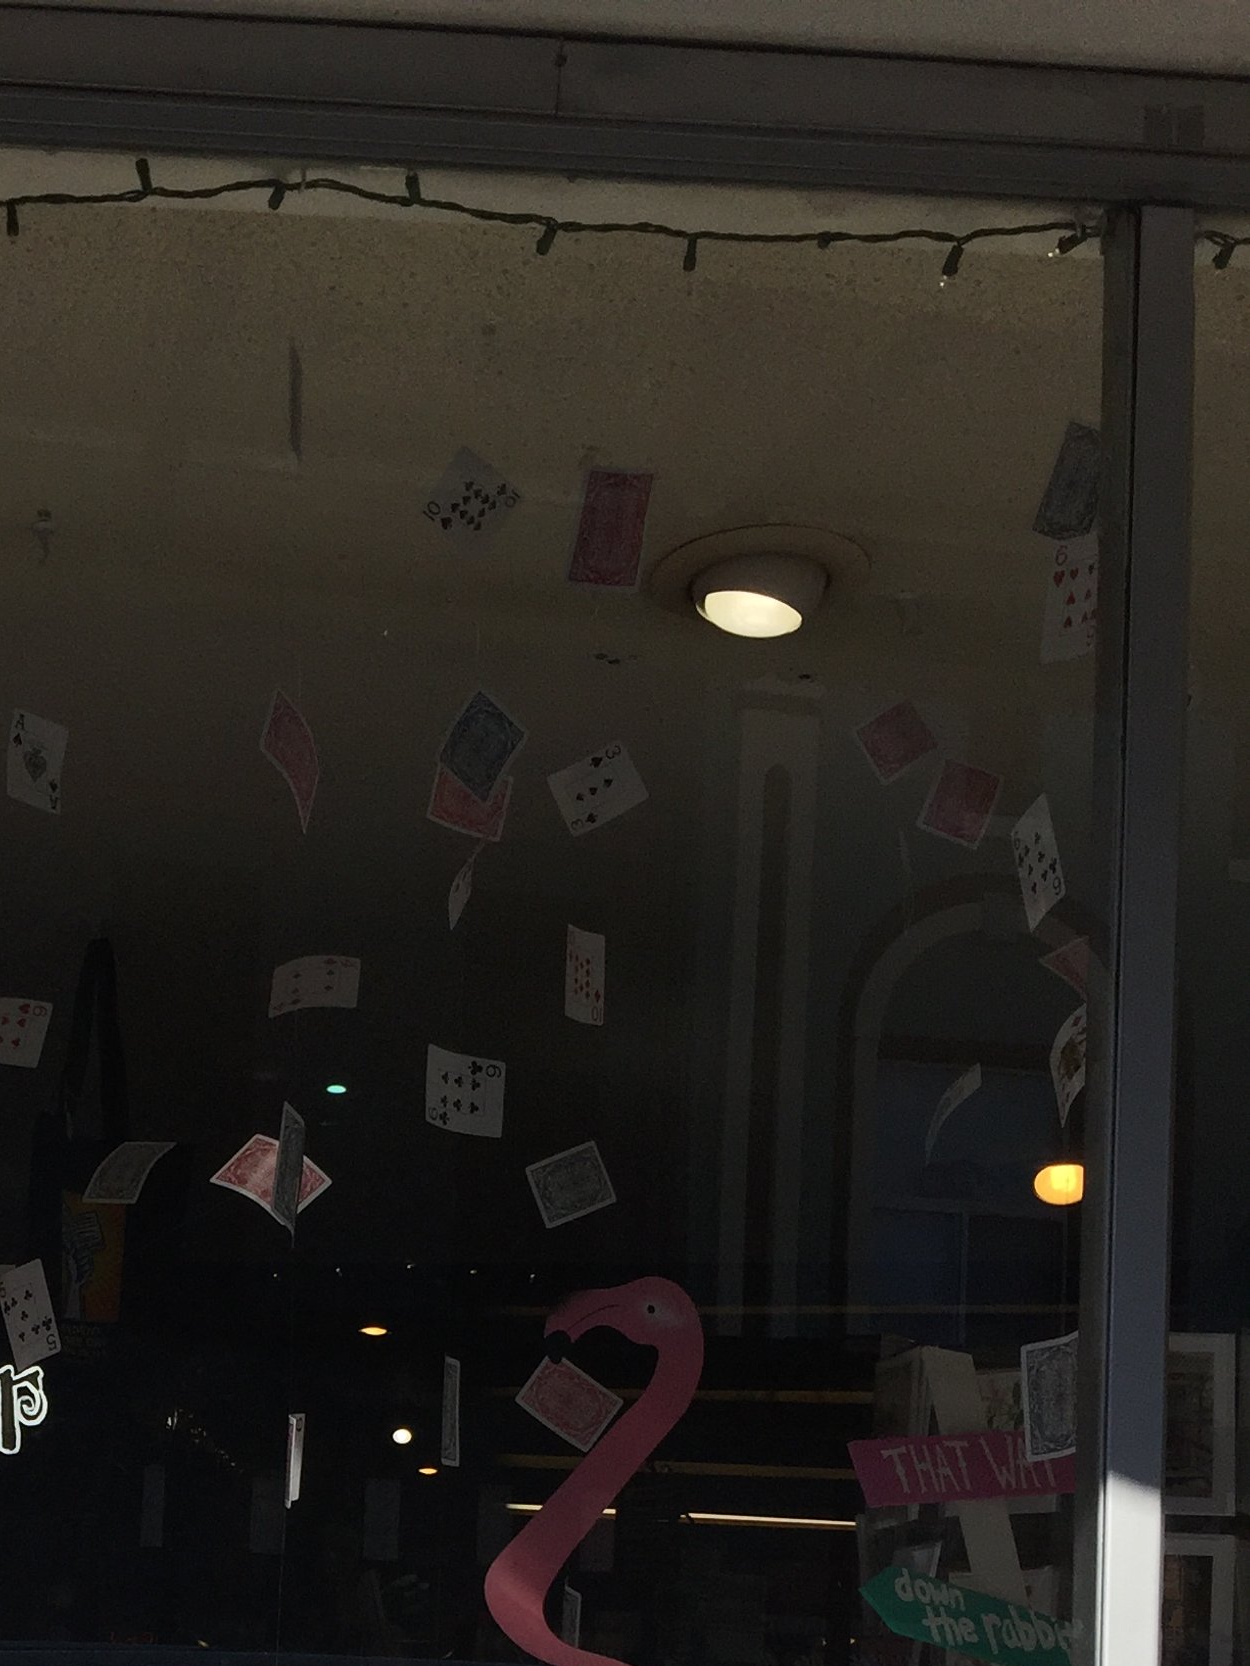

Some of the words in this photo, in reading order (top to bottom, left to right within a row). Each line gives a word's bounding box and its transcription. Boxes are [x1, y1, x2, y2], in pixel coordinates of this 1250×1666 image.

[881, 1439, 973, 1494] THAT
[894, 1567, 966, 1612] down
[922, 1605, 979, 1647] the
